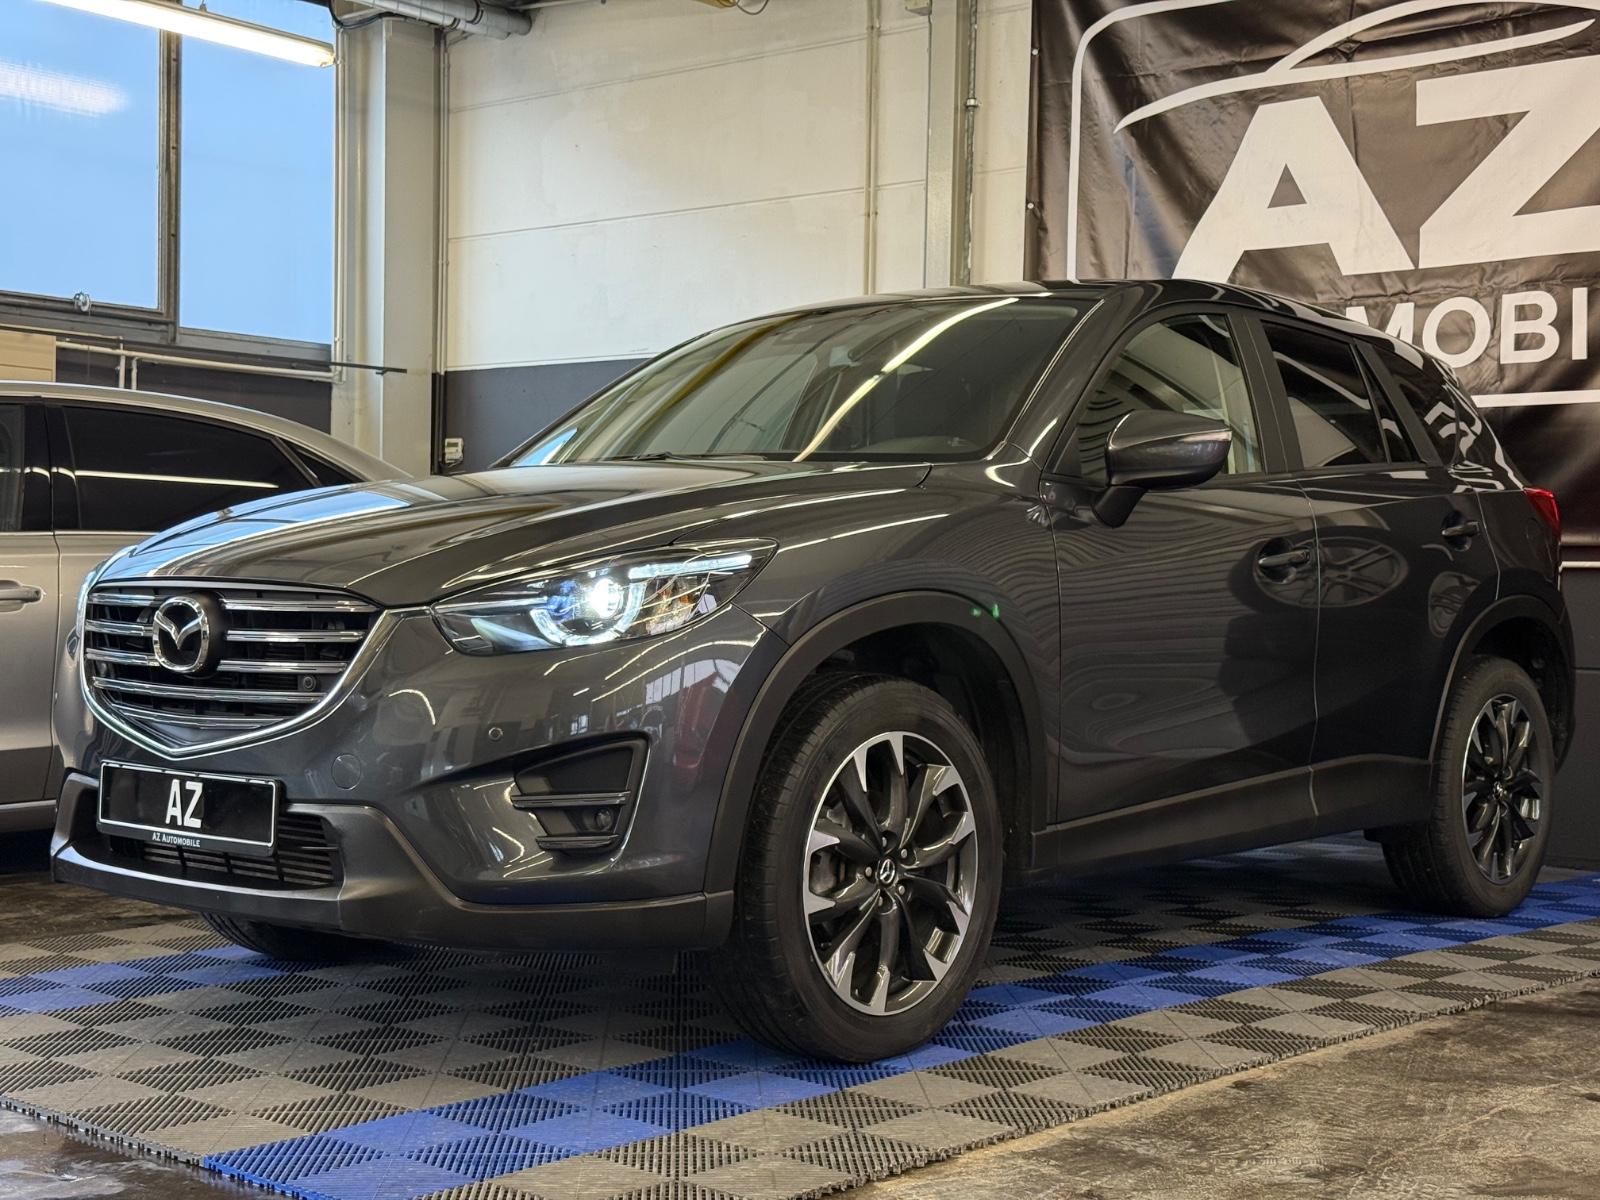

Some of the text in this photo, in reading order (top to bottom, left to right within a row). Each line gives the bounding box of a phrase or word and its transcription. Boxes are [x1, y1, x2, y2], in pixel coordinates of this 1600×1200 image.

[1171, 55, 1600, 282] AZ
[165, 778, 203, 829] AZ
[152, 832, 161, 841] AZ
